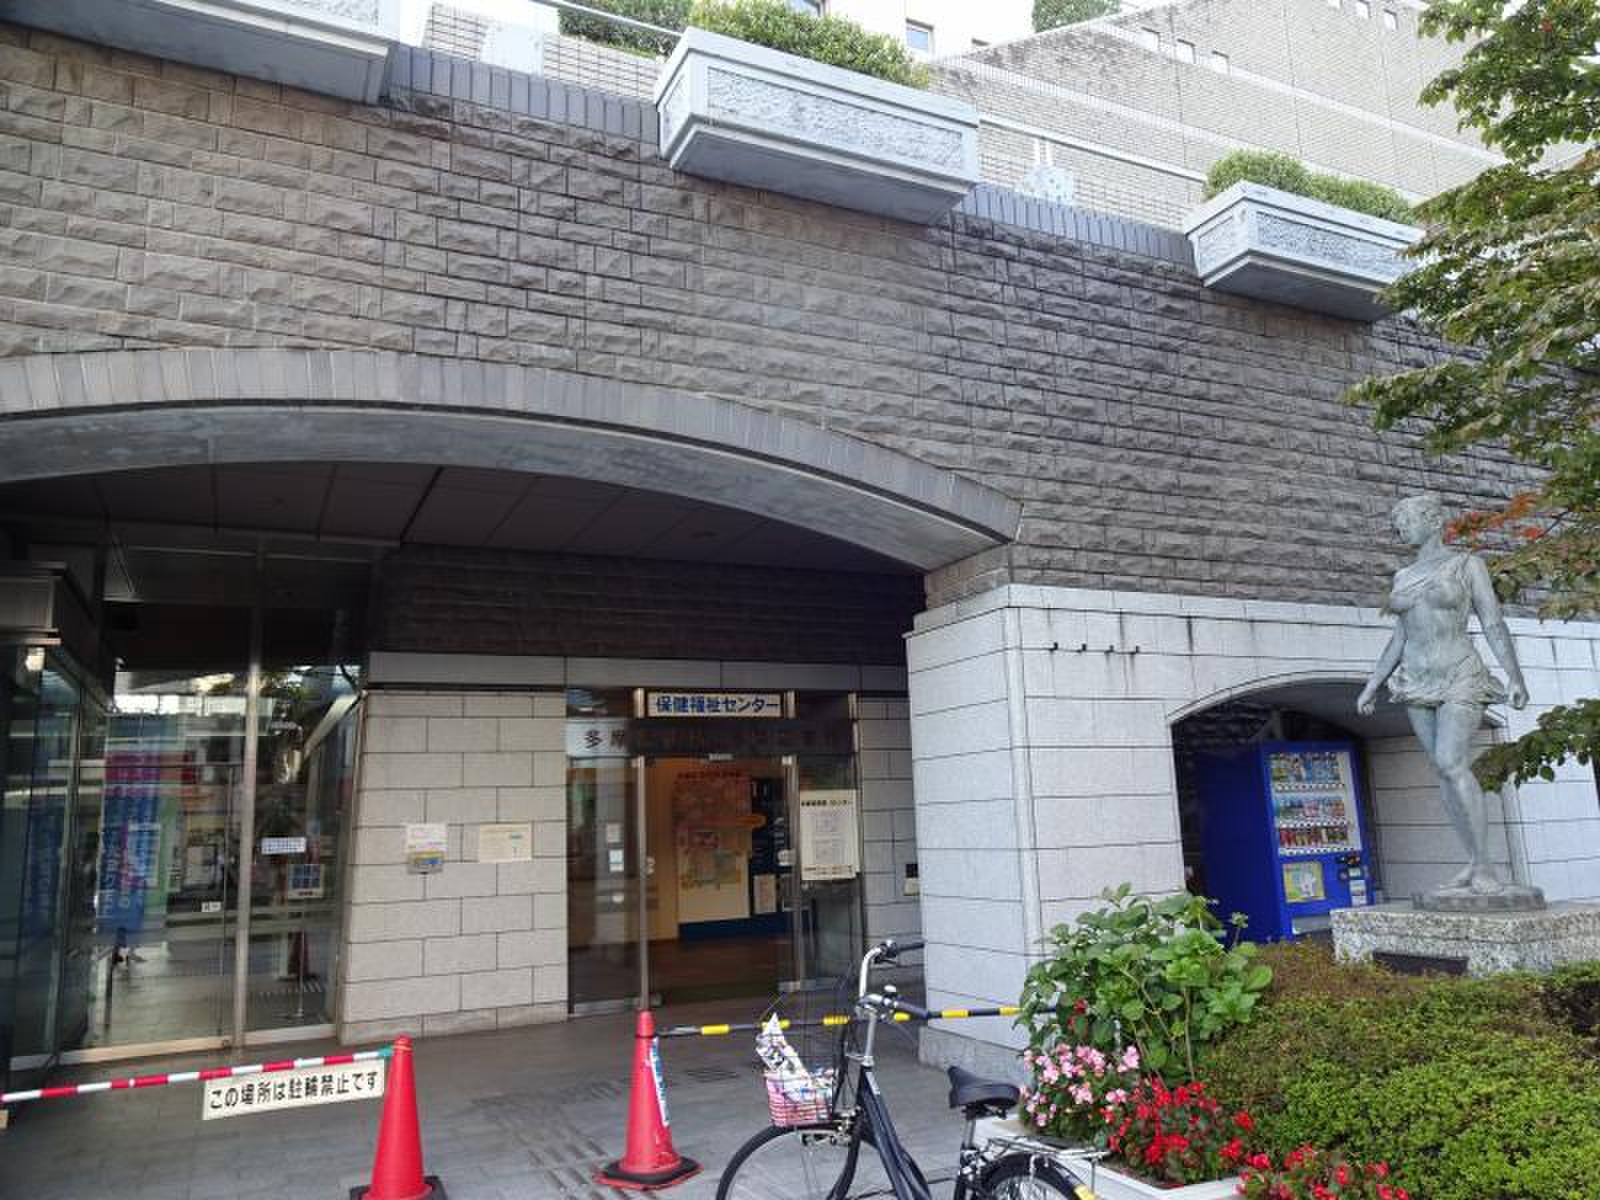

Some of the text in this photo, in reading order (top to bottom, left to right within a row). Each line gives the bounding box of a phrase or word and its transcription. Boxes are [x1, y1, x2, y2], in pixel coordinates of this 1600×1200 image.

[656, 695, 778, 712] 保健福祉センター
[210, 1071, 378, 1109] この場所は駐輪禁止です
